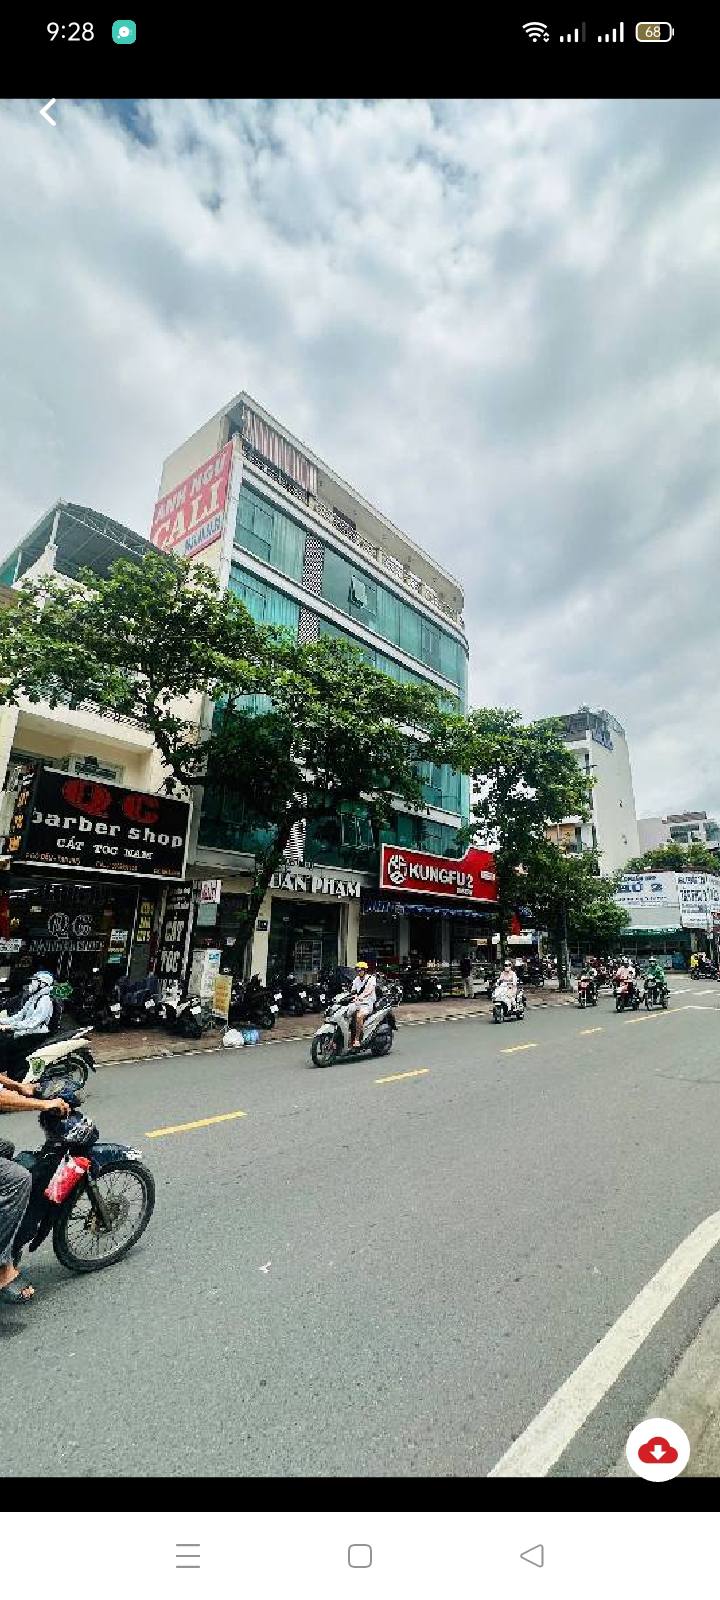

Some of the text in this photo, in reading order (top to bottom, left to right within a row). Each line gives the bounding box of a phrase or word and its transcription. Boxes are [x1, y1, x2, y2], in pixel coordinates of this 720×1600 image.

[152, 479, 222, 552] CALI
[31, 807, 184, 848] barber shop
